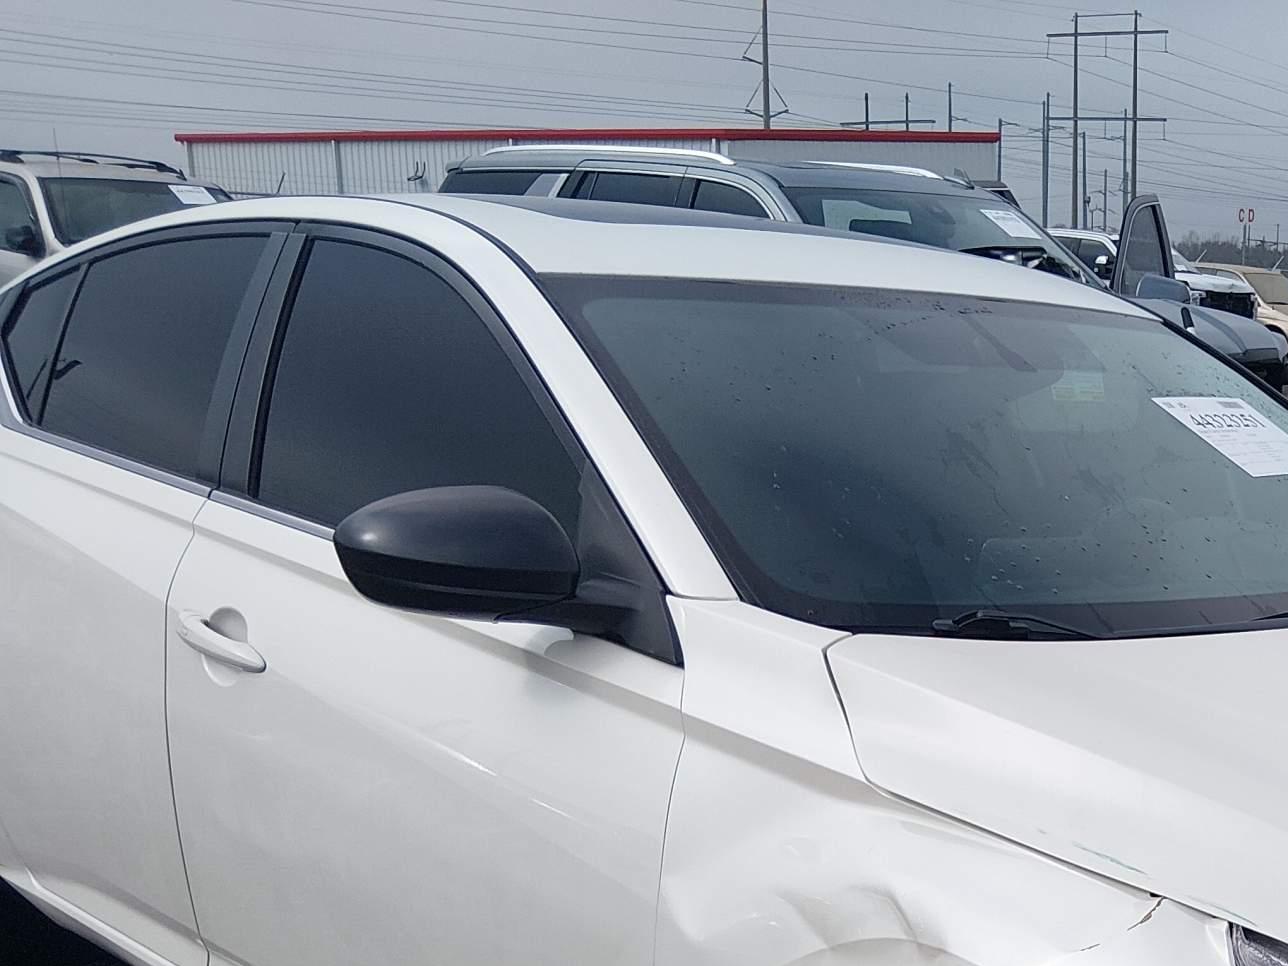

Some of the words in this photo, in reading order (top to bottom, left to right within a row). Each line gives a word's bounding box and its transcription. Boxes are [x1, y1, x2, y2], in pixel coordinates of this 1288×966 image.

[1238, 208, 1245, 223] C
[1248, 208, 1255, 223] D
[1189, 413, 1266, 429] 44323251
